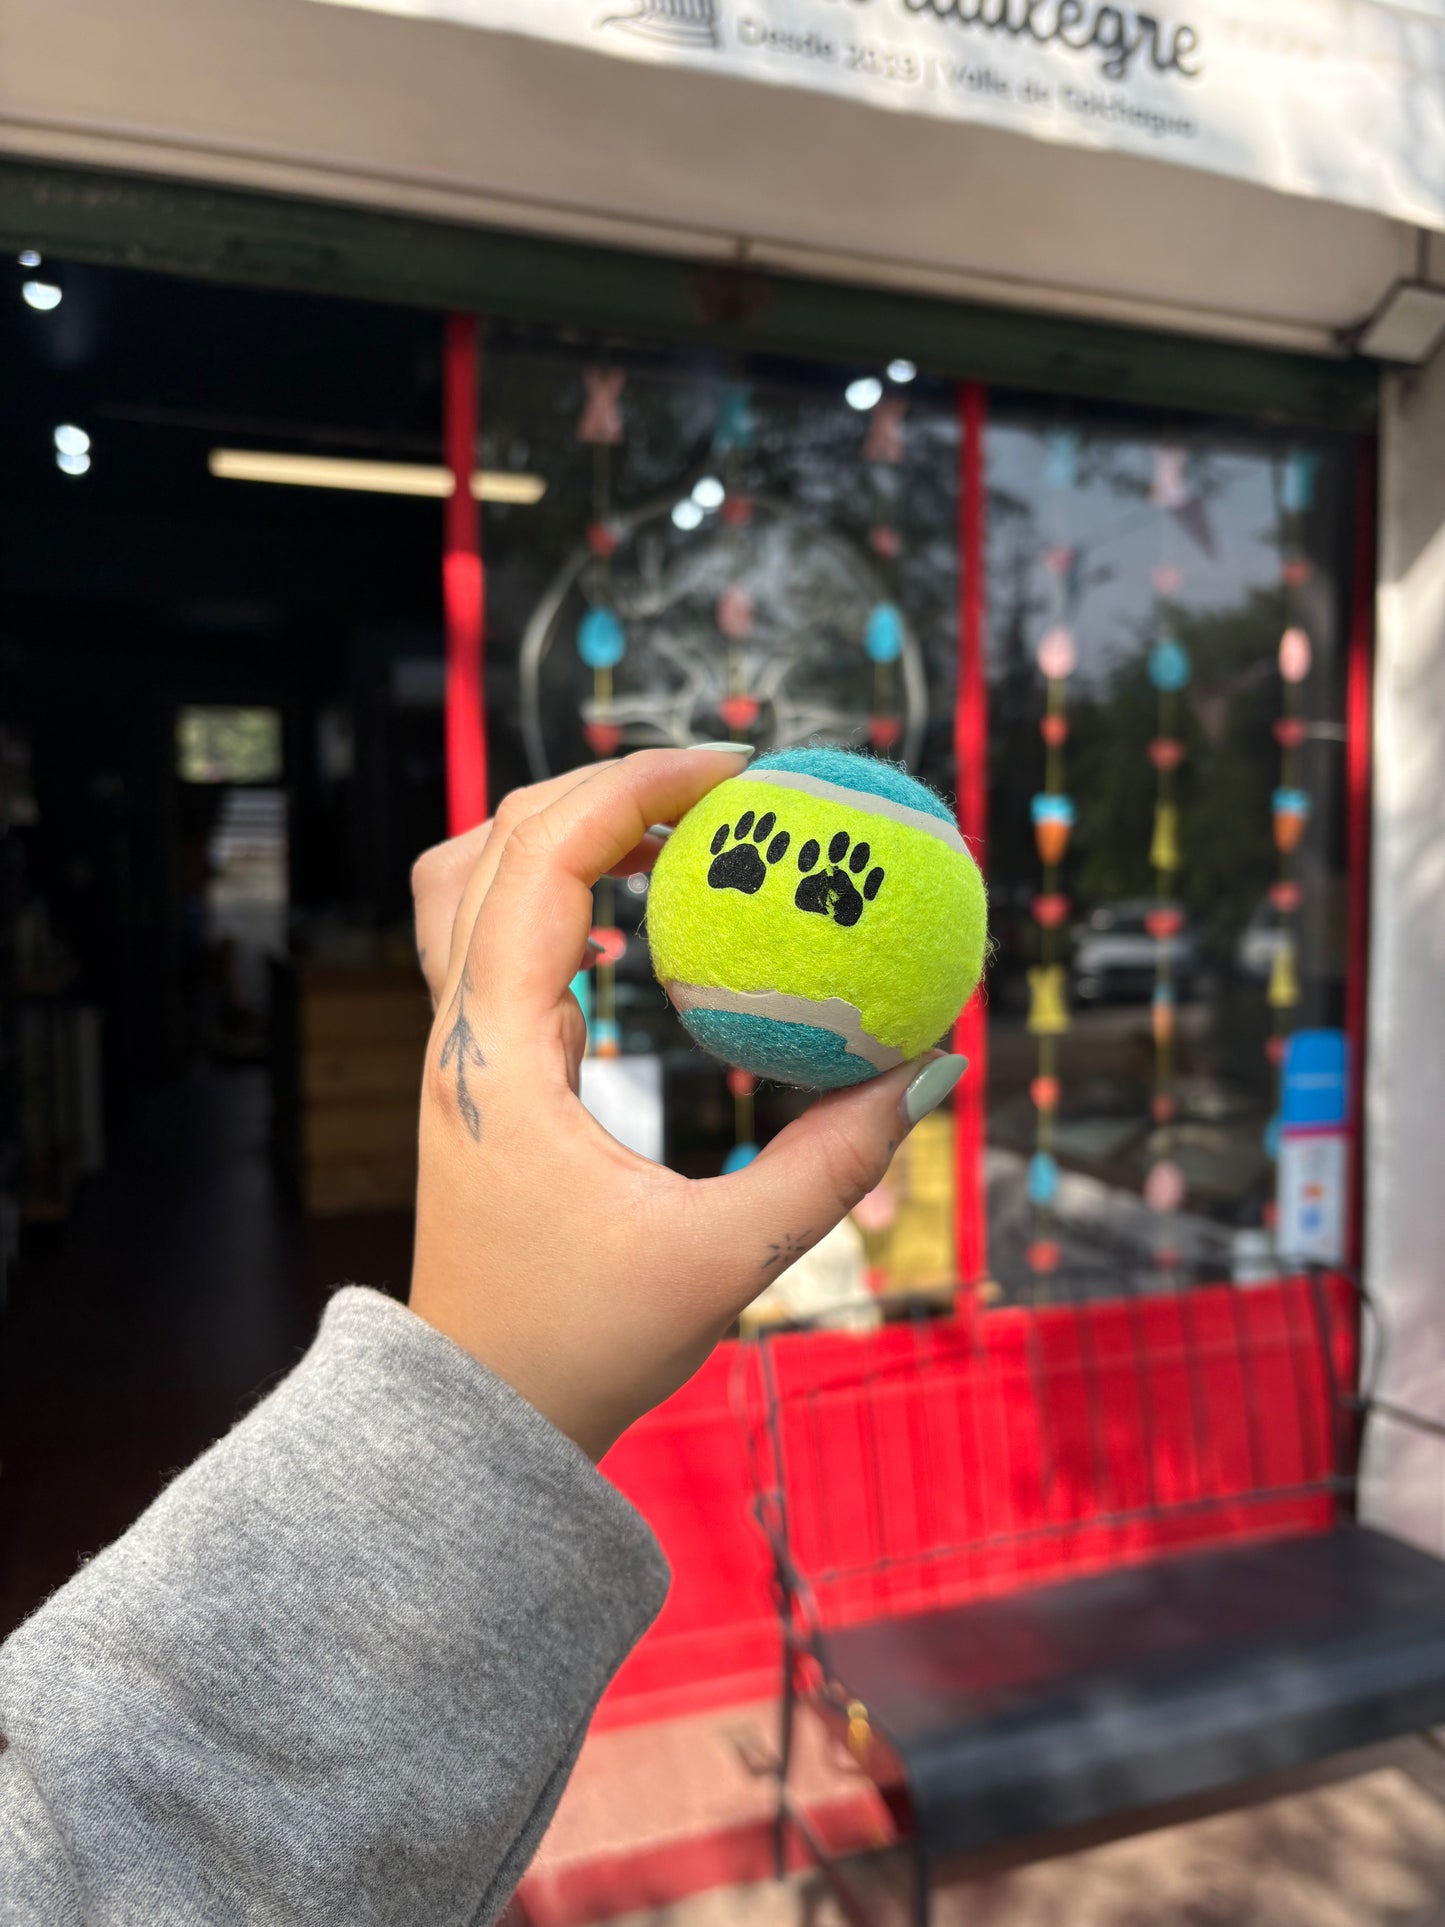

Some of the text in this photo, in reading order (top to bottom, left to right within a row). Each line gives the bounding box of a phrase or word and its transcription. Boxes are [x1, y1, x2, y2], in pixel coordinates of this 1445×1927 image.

[738, 17, 837, 63] Desde
[949, 62, 1011, 95] Valle
[1018, 77, 1050, 104] de
